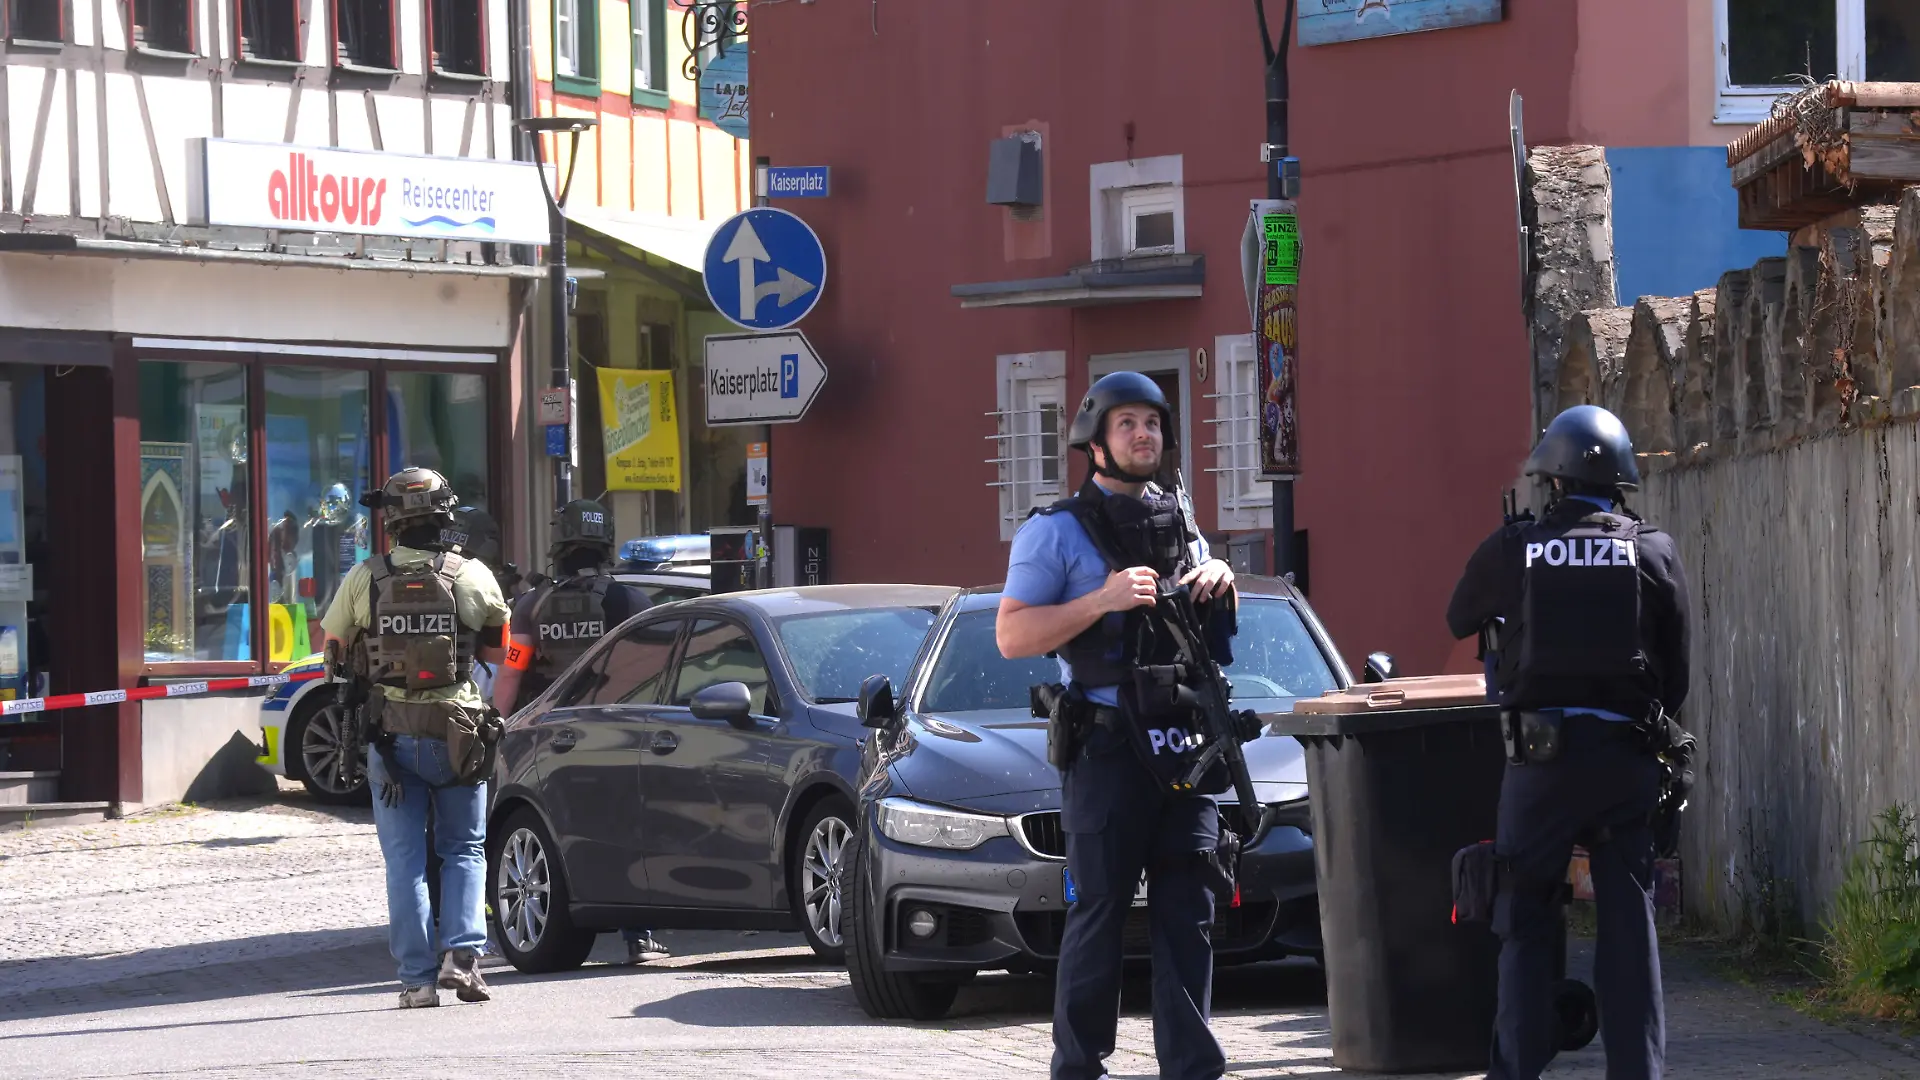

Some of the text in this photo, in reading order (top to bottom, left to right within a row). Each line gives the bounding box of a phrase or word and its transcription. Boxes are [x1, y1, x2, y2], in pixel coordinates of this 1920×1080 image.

[716, 83, 732, 95] LA
[268, 152, 494, 226] alltours Reisecenter
[771, 172, 823, 195] Kaiserplatz
[1196, 347, 1208, 383] 9
[710, 360, 795, 400] Kaiserplatz P
[582, 511, 604, 524] POLIZEI
[1526, 538, 1637, 568] POLIZEI
[379, 613, 456, 635] POLIZEI
[539, 620, 604, 640] POLIZEI
